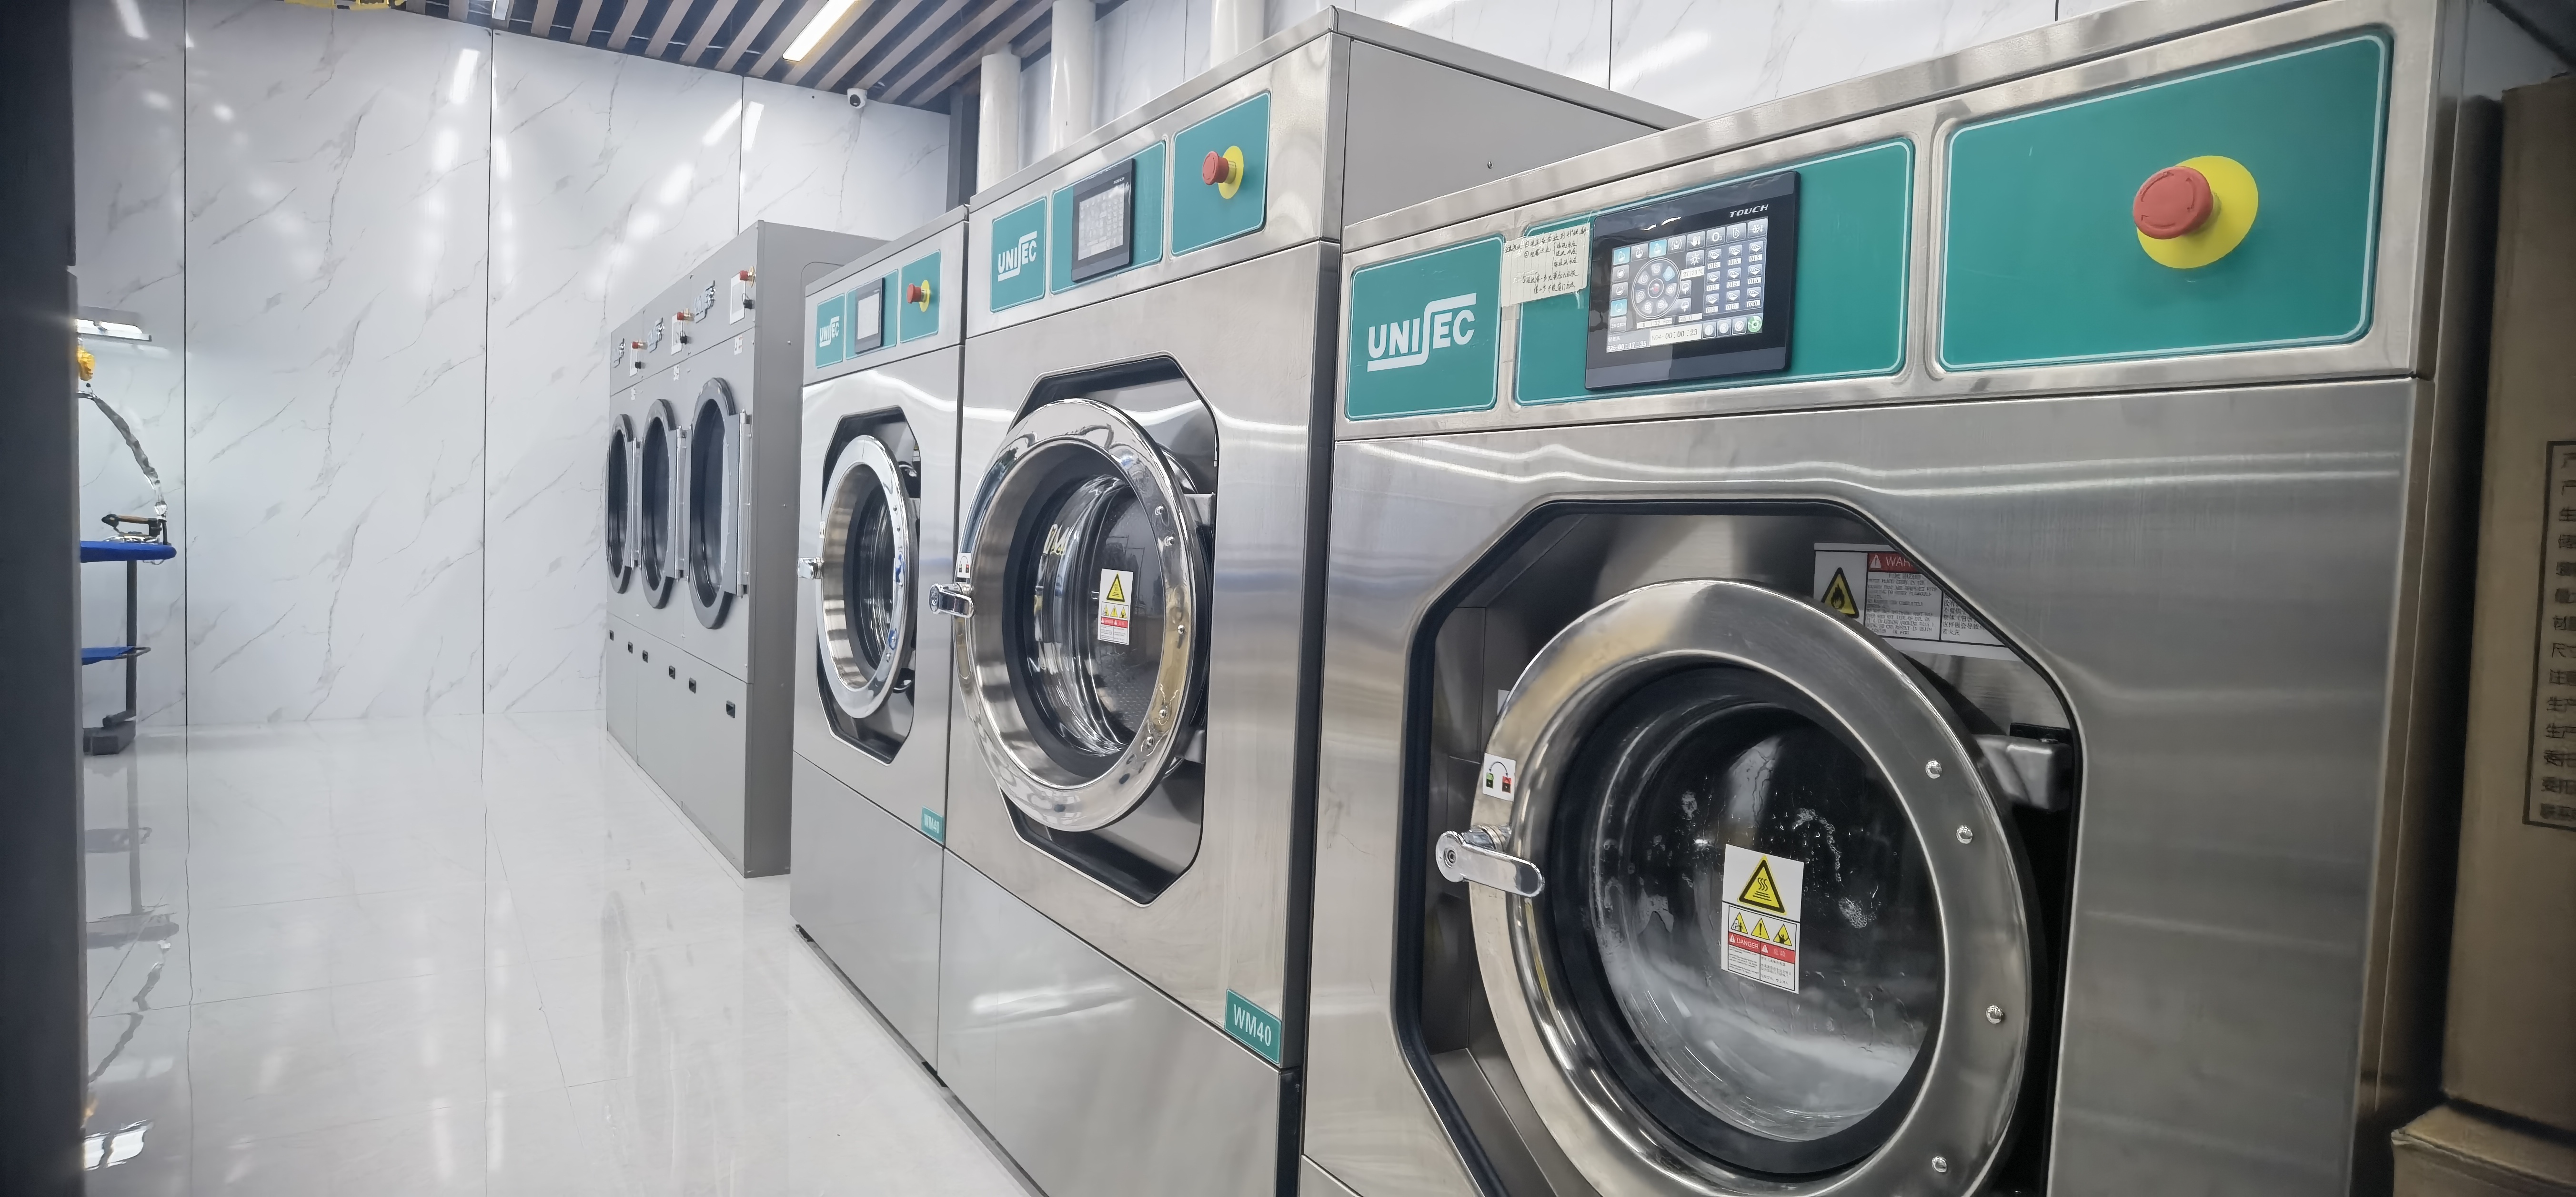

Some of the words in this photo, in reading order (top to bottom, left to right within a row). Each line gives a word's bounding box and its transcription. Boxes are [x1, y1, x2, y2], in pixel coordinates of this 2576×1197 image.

[1730, 204, 1769, 218] TOUCH
[997, 230, 1037, 282] UNISEC
[1367, 292, 1477, 372] UNISEC
[1737, 938, 1759, 950] DANGER
[1234, 1004, 1271, 1046] WM40
